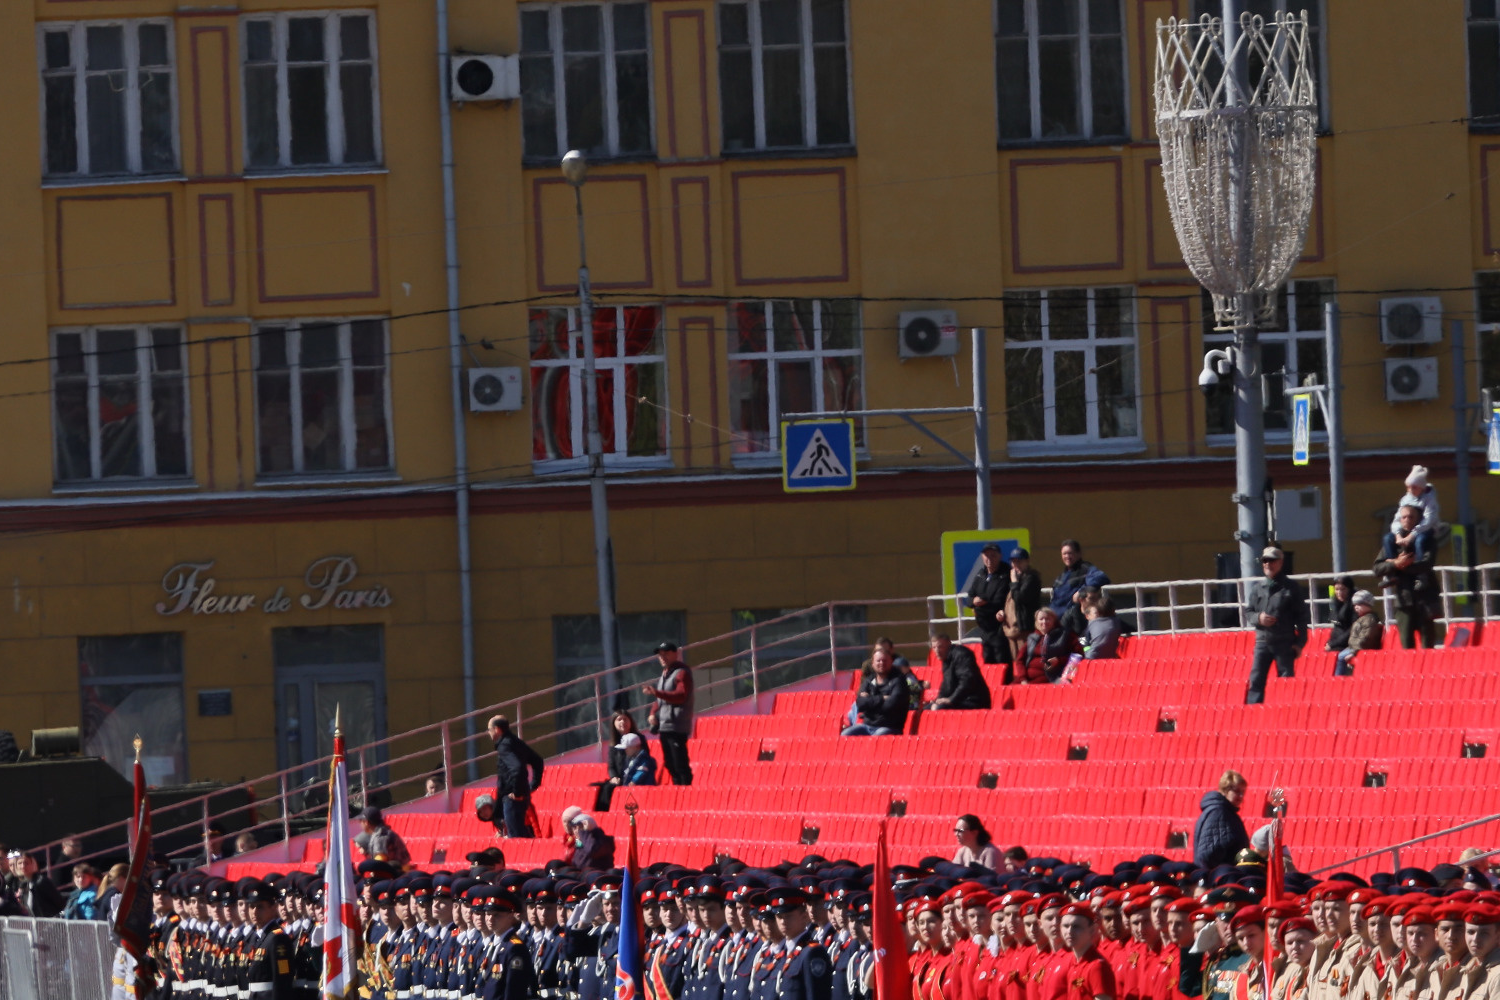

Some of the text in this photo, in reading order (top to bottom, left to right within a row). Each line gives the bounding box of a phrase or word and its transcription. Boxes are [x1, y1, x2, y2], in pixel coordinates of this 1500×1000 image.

[155, 555, 394, 617] Fleur de Paris
